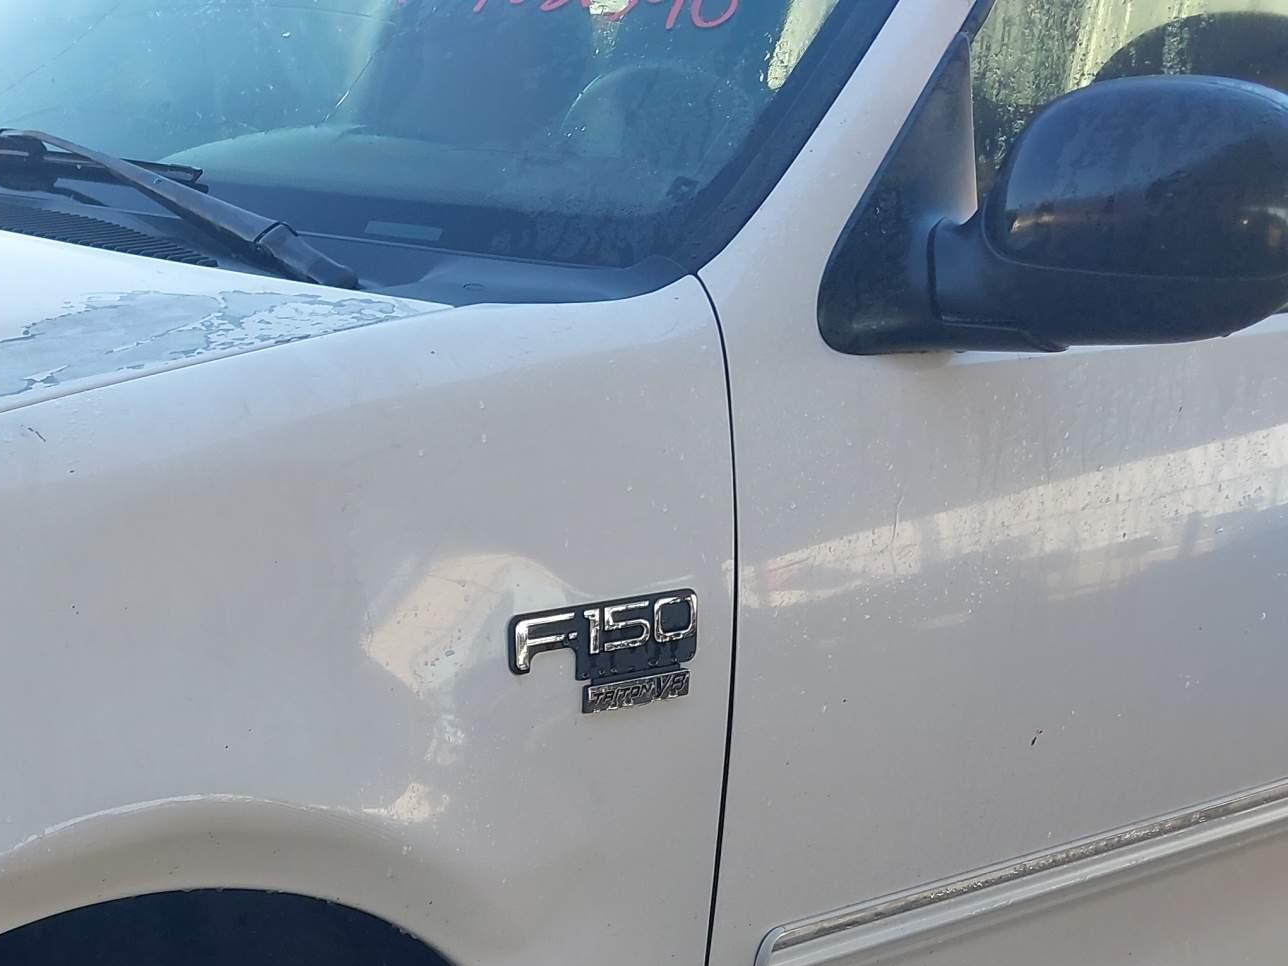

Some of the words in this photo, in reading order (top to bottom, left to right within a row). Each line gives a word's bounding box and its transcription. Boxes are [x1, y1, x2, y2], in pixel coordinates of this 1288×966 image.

[513, 592, 698, 672] F-150
[589, 682, 654, 708] TRITON
[651, 671, 690, 698] V8
